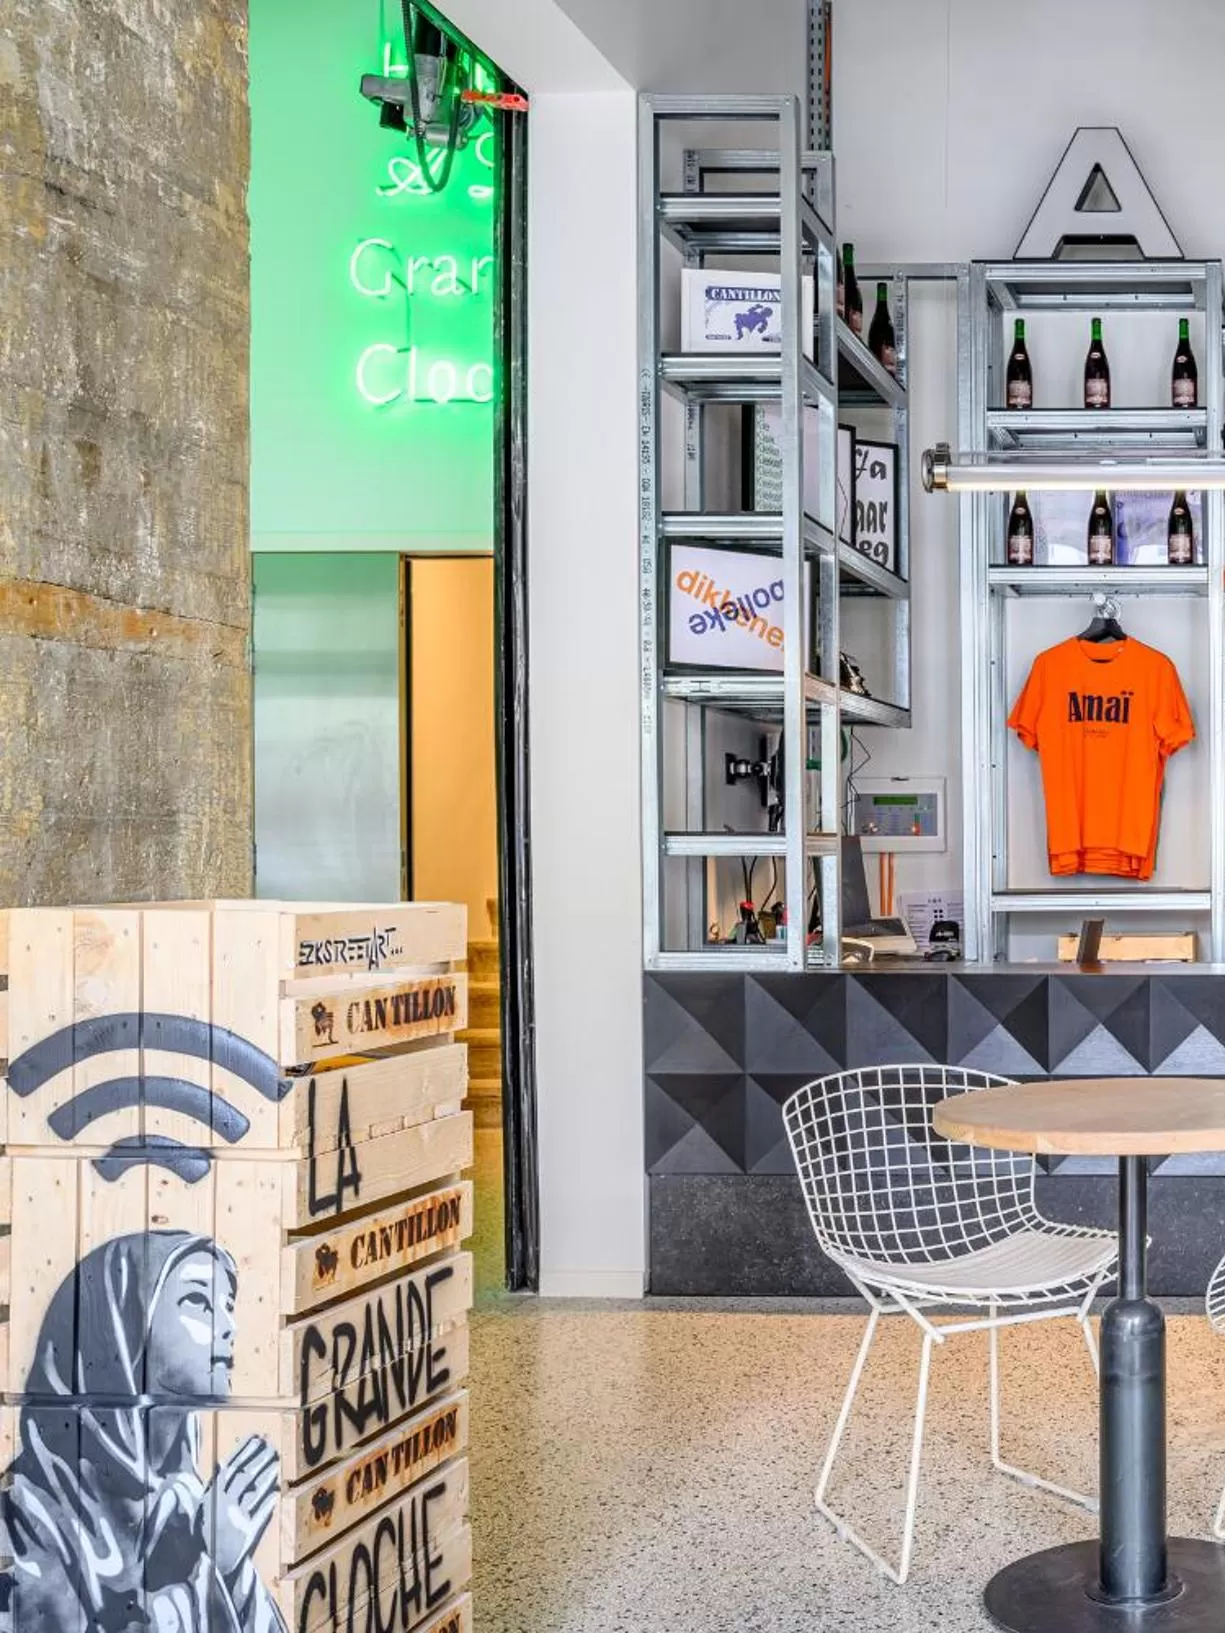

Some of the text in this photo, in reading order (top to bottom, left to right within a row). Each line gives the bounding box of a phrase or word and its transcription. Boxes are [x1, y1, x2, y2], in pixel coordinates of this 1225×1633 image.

[1012, 126, 1185, 261] A
[1067, 690, 1135, 725] Amaï
[347, 986, 457, 1035] CANTILLON
[308, 1077, 362, 1218] LA
[350, 1194, 462, 1270] CANTILLON
[300, 1266, 454, 1467] GRANDE
[346, 1407, 458, 1506] CANTILLON
